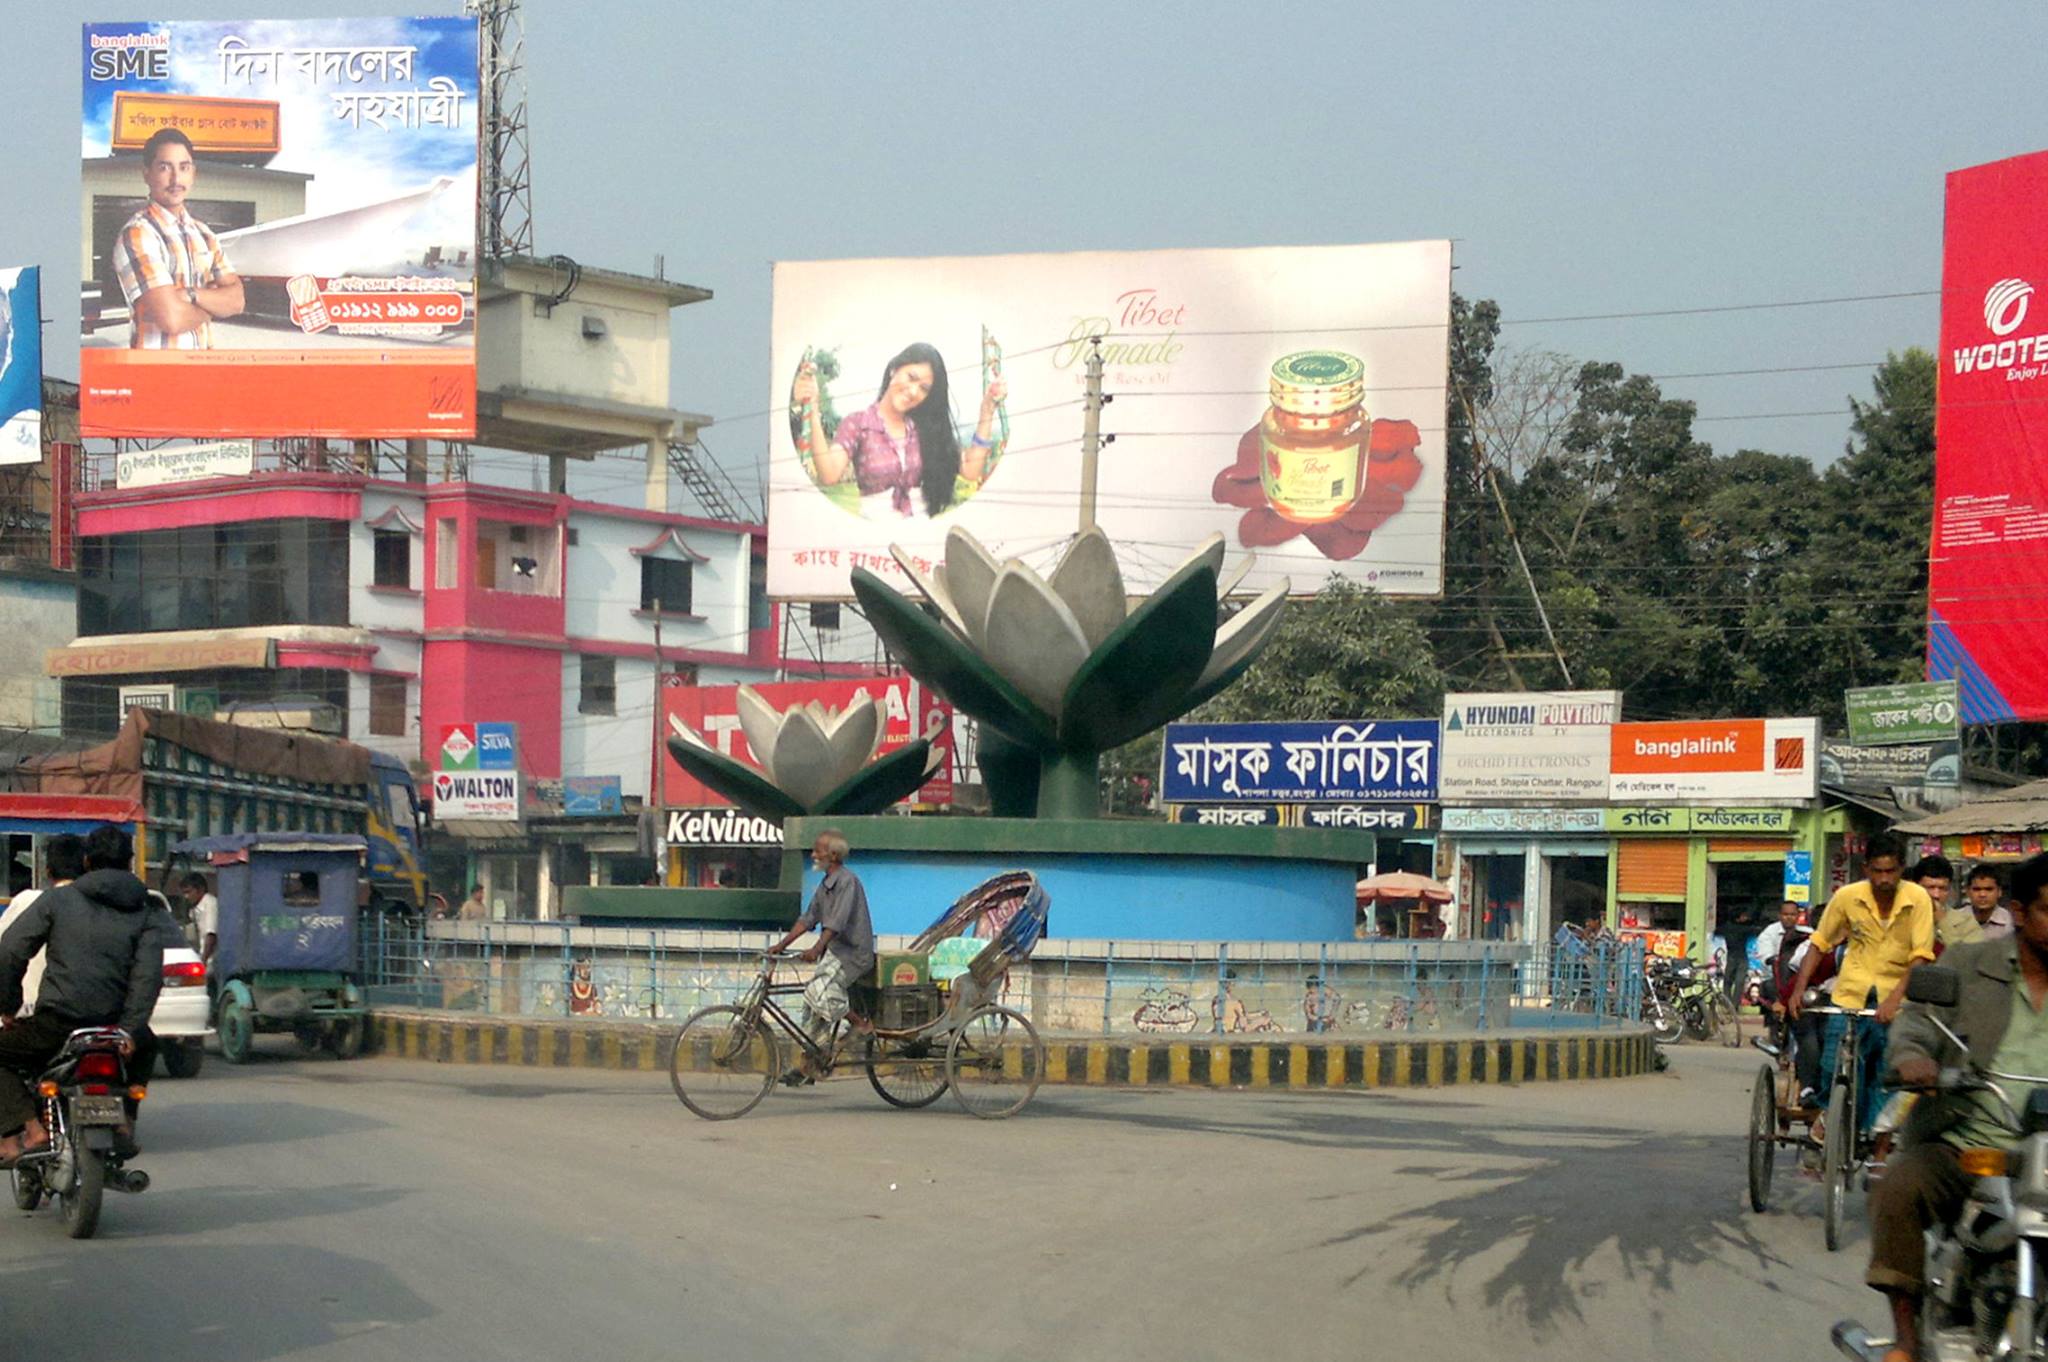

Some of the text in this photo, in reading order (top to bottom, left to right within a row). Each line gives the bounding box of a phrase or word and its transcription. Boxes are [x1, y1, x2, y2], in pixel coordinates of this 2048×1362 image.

[91, 34, 168, 48] banglalink
[92, 49, 168, 79] SME
[218, 35, 417, 84] দিন বদলের
[330, 76, 467, 132] সহযাত্রী
[330, 302, 458, 319] ০১৯১২ ৯৯৯ ০০০
[1116, 288, 1186, 328] Tibet
[1052, 315, 1184, 370] Pomade
[2006, 366, 2039, 382] Enjoy
[792, 549, 840, 568] কাছে
[1466, 705, 1535, 725] HYUNDAI
[1540, 704, 1613, 725] POLYTRON
[481, 733, 513, 751] SILVA
[1465, 728, 1534, 737] ELECTRONICS
[1635, 738, 1736, 758] banglalink
[1173, 722, 1433, 798] মাসুক ফার্নিচার
[1457, 755, 1591, 769] ORCHID ELECTRONICS
[453, 777, 514, 798] WALTON
[1444, 777, 1473, 787] Station
[1500, 777, 1529, 790] Shapla
[1311, 805, 1406, 828] ফার্নিচার
